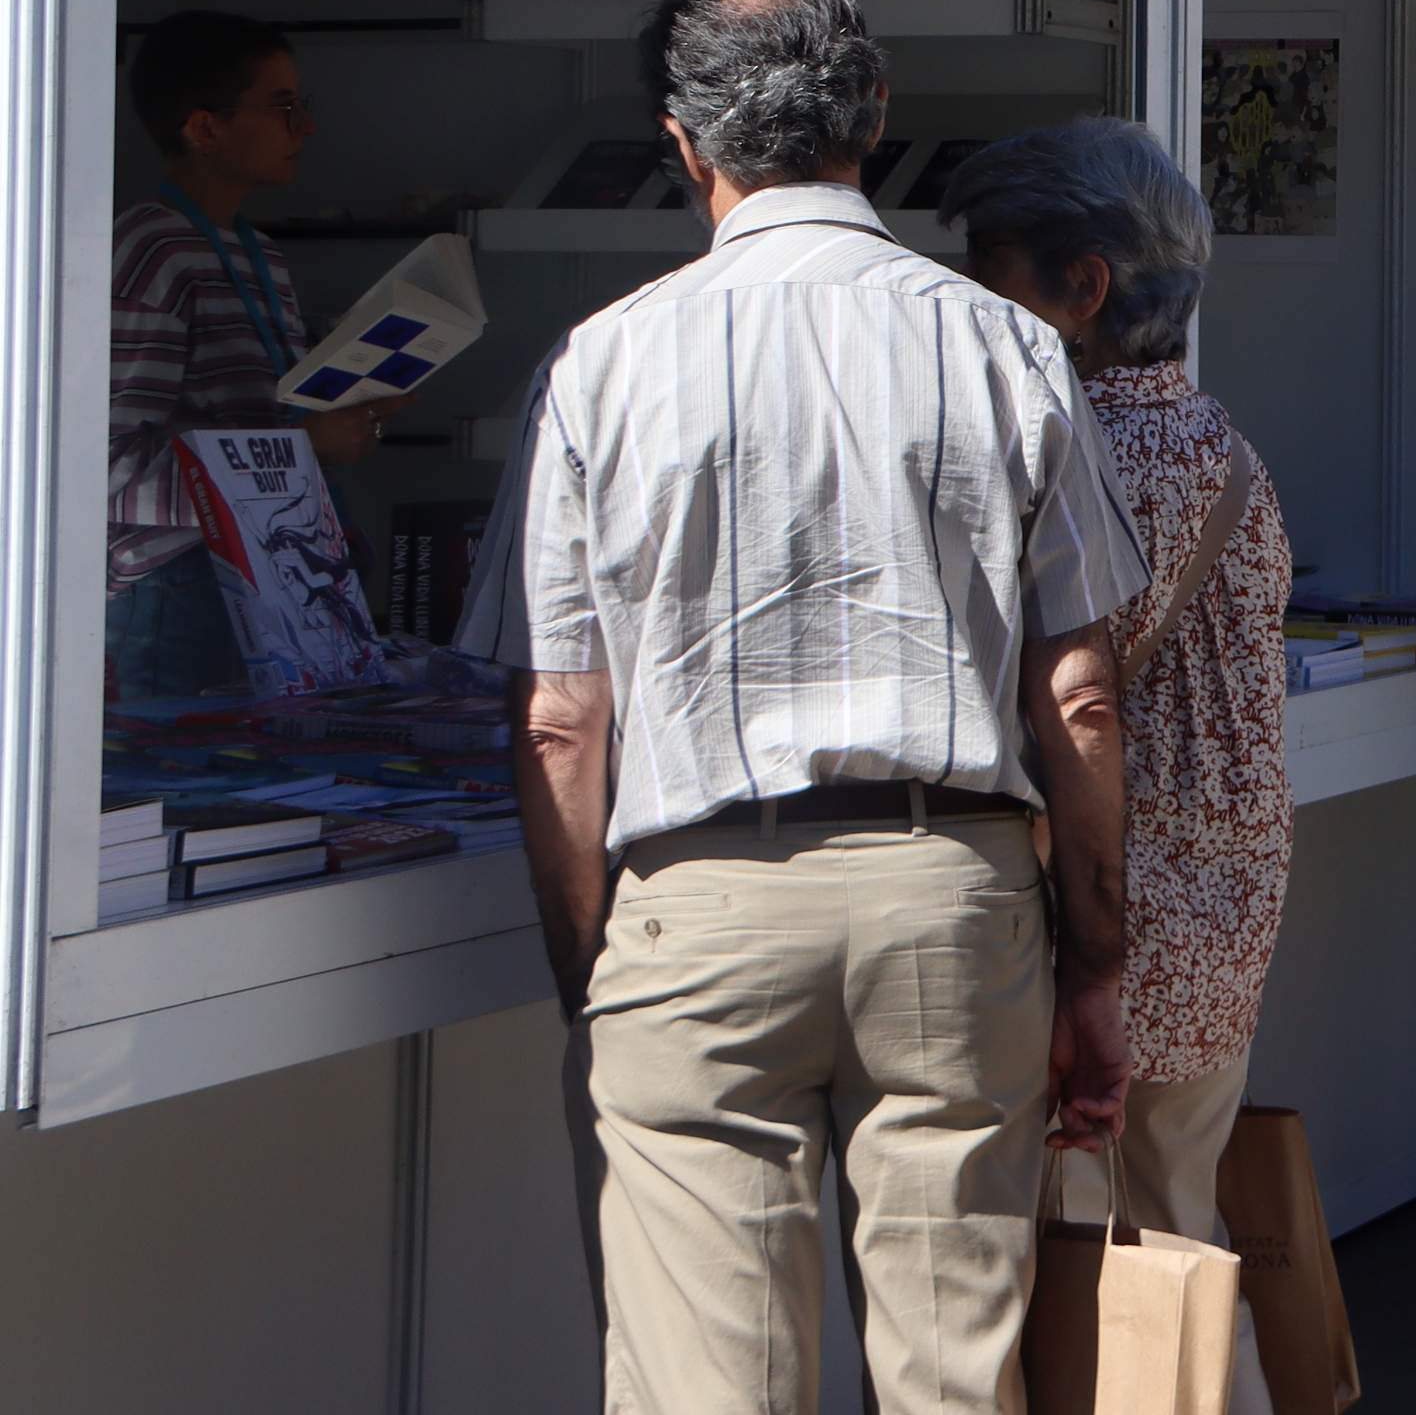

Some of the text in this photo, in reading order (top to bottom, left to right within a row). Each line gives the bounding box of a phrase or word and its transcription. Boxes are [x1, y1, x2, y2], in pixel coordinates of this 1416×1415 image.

[218, 437, 296, 471] EL GRAN
[252, 470, 289, 494] BUIT
